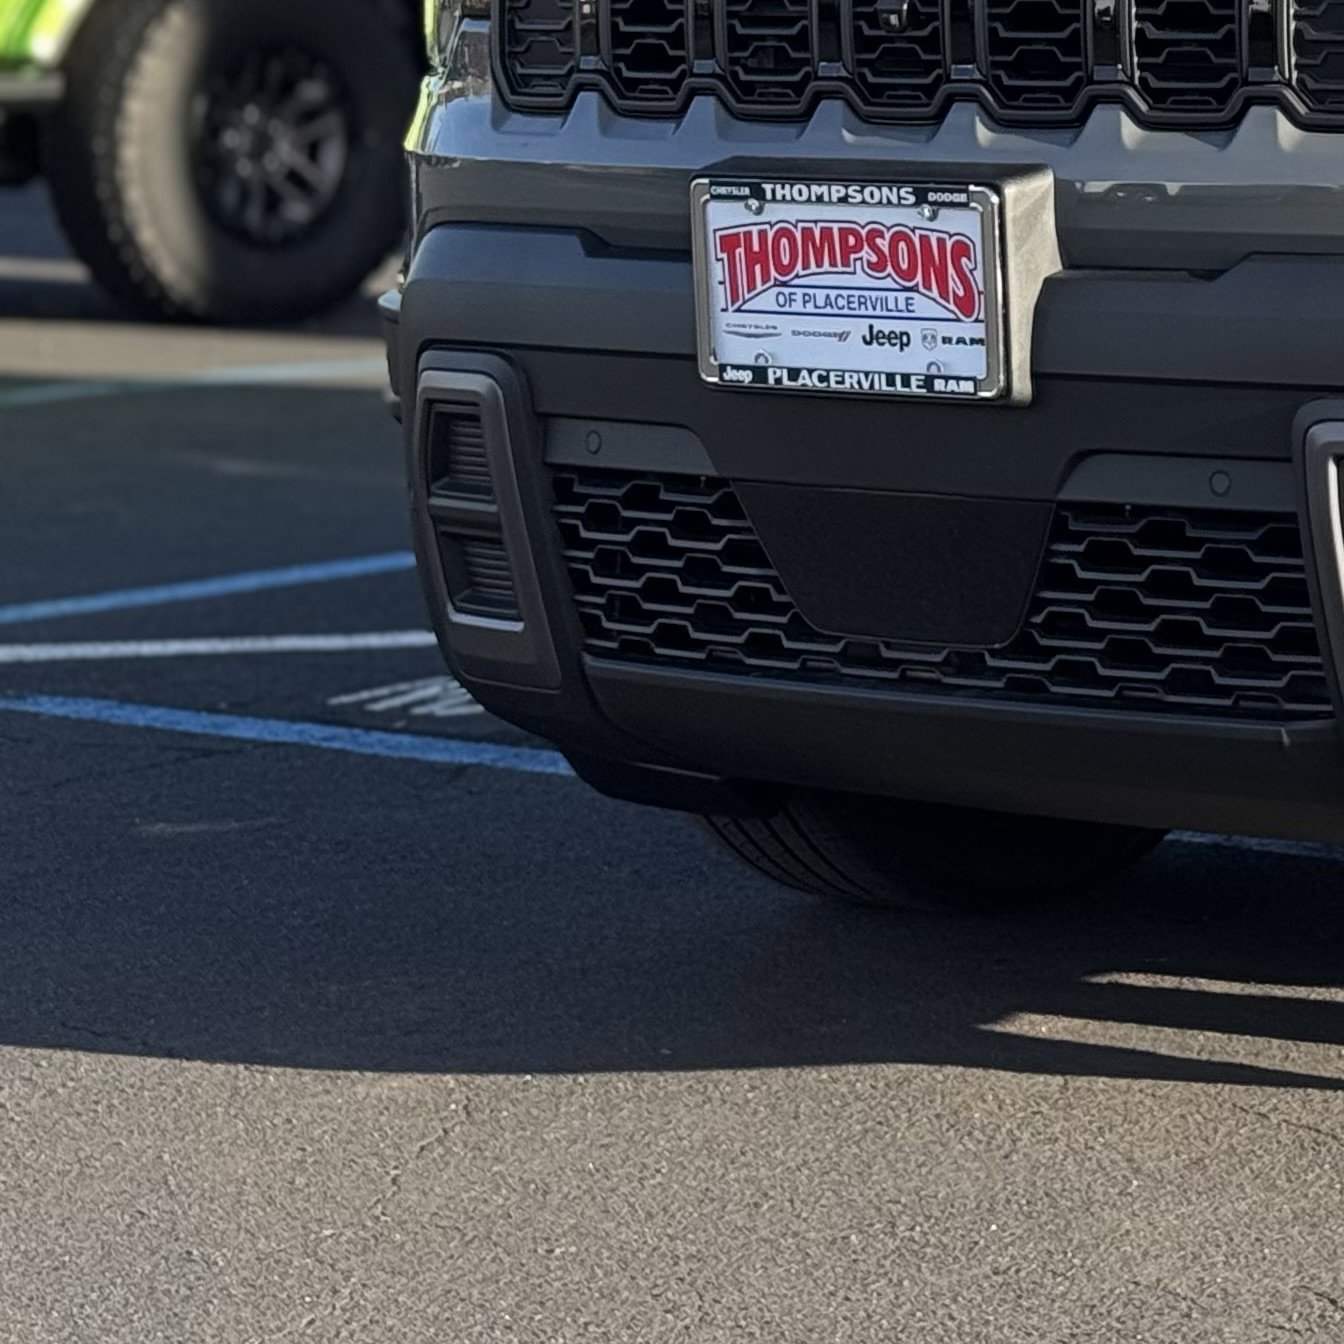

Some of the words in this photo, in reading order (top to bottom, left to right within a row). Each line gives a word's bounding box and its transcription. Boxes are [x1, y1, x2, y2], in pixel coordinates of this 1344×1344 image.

[710, 185, 751, 196] CHRYSLER
[761, 183, 916, 205] THOMPSONS
[927, 191, 968, 203] DODGE
[716, 224, 980, 320] THOMPSONS
[775, 292, 799, 309] OF
[802, 293, 916, 314] PLACERVILLE
[861, 323, 912, 353] Jeep
[941, 335, 986, 347] RAM
[722, 365, 753, 384] Jeep
[767, 367, 928, 393] PLACERVILLE
[933, 378, 975, 394] RAM
